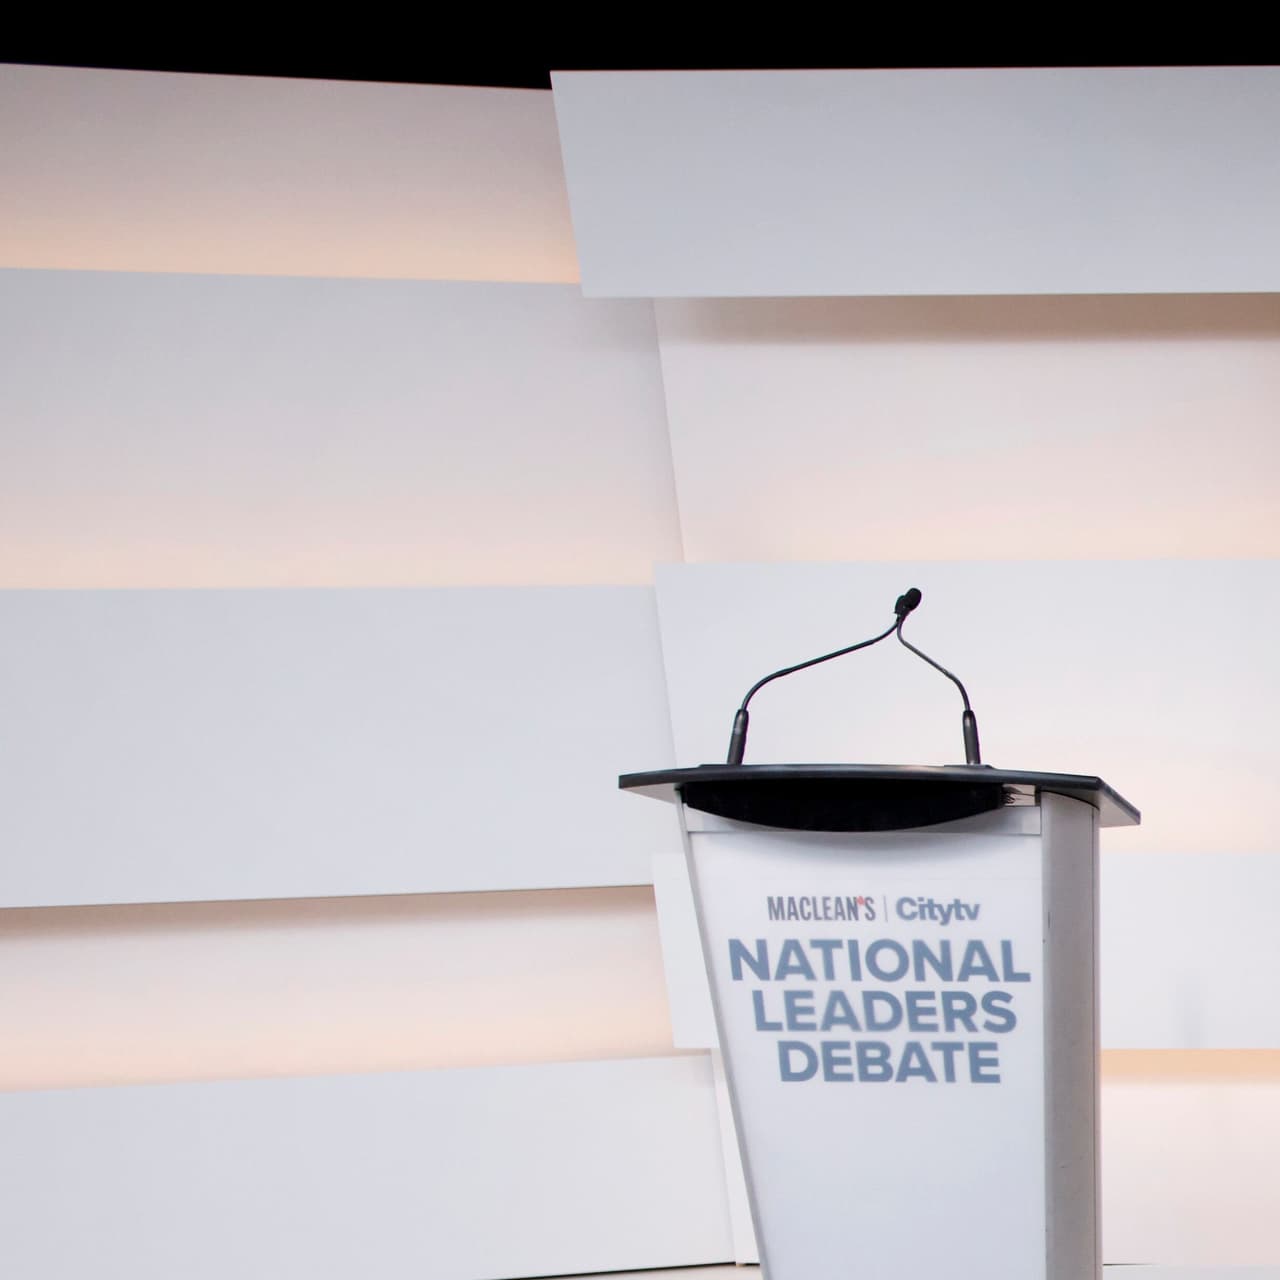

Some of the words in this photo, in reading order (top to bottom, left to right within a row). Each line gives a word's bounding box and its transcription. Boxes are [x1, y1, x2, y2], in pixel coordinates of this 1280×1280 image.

[895, 896, 981, 926] Citytv
[728, 938, 1032, 983] NATIONAL
[751, 989, 1018, 1034] LEADERS
[776, 1040, 1001, 1084] DEBATE
